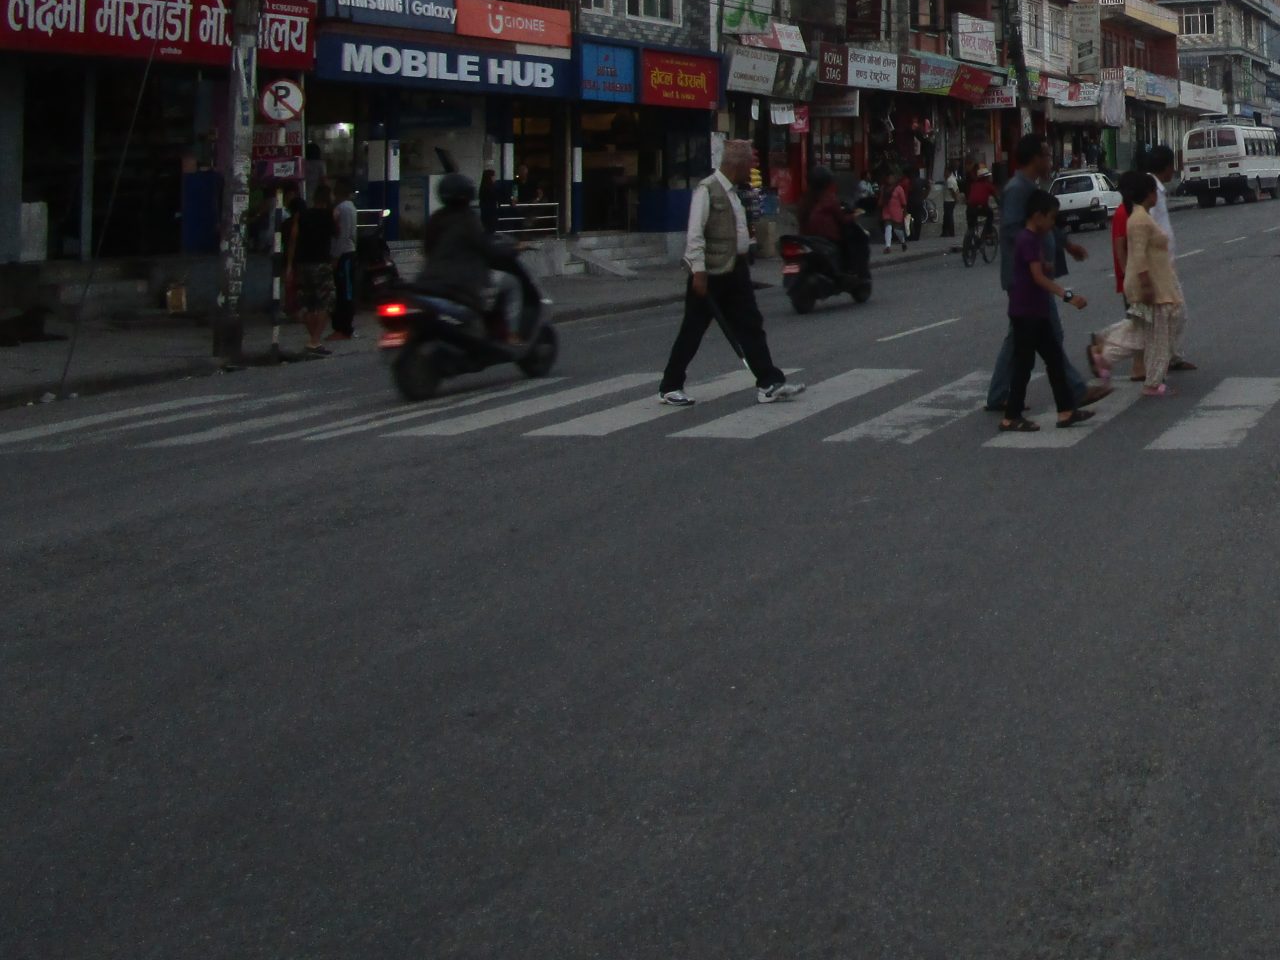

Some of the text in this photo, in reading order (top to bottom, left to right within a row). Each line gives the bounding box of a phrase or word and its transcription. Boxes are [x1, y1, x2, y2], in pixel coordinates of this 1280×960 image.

[412, 1, 458, 25] Galaxy
[504, 14, 545, 33] GIONEE
[340, 42, 555, 88] MOBILE HUB
[823, 52, 843, 67] ROYAL
[825, 67, 842, 81] STAG
[901, 63, 917, 77] ROYAL
[902, 76, 915, 89] STAG
[274, 85, 291, 107] P
